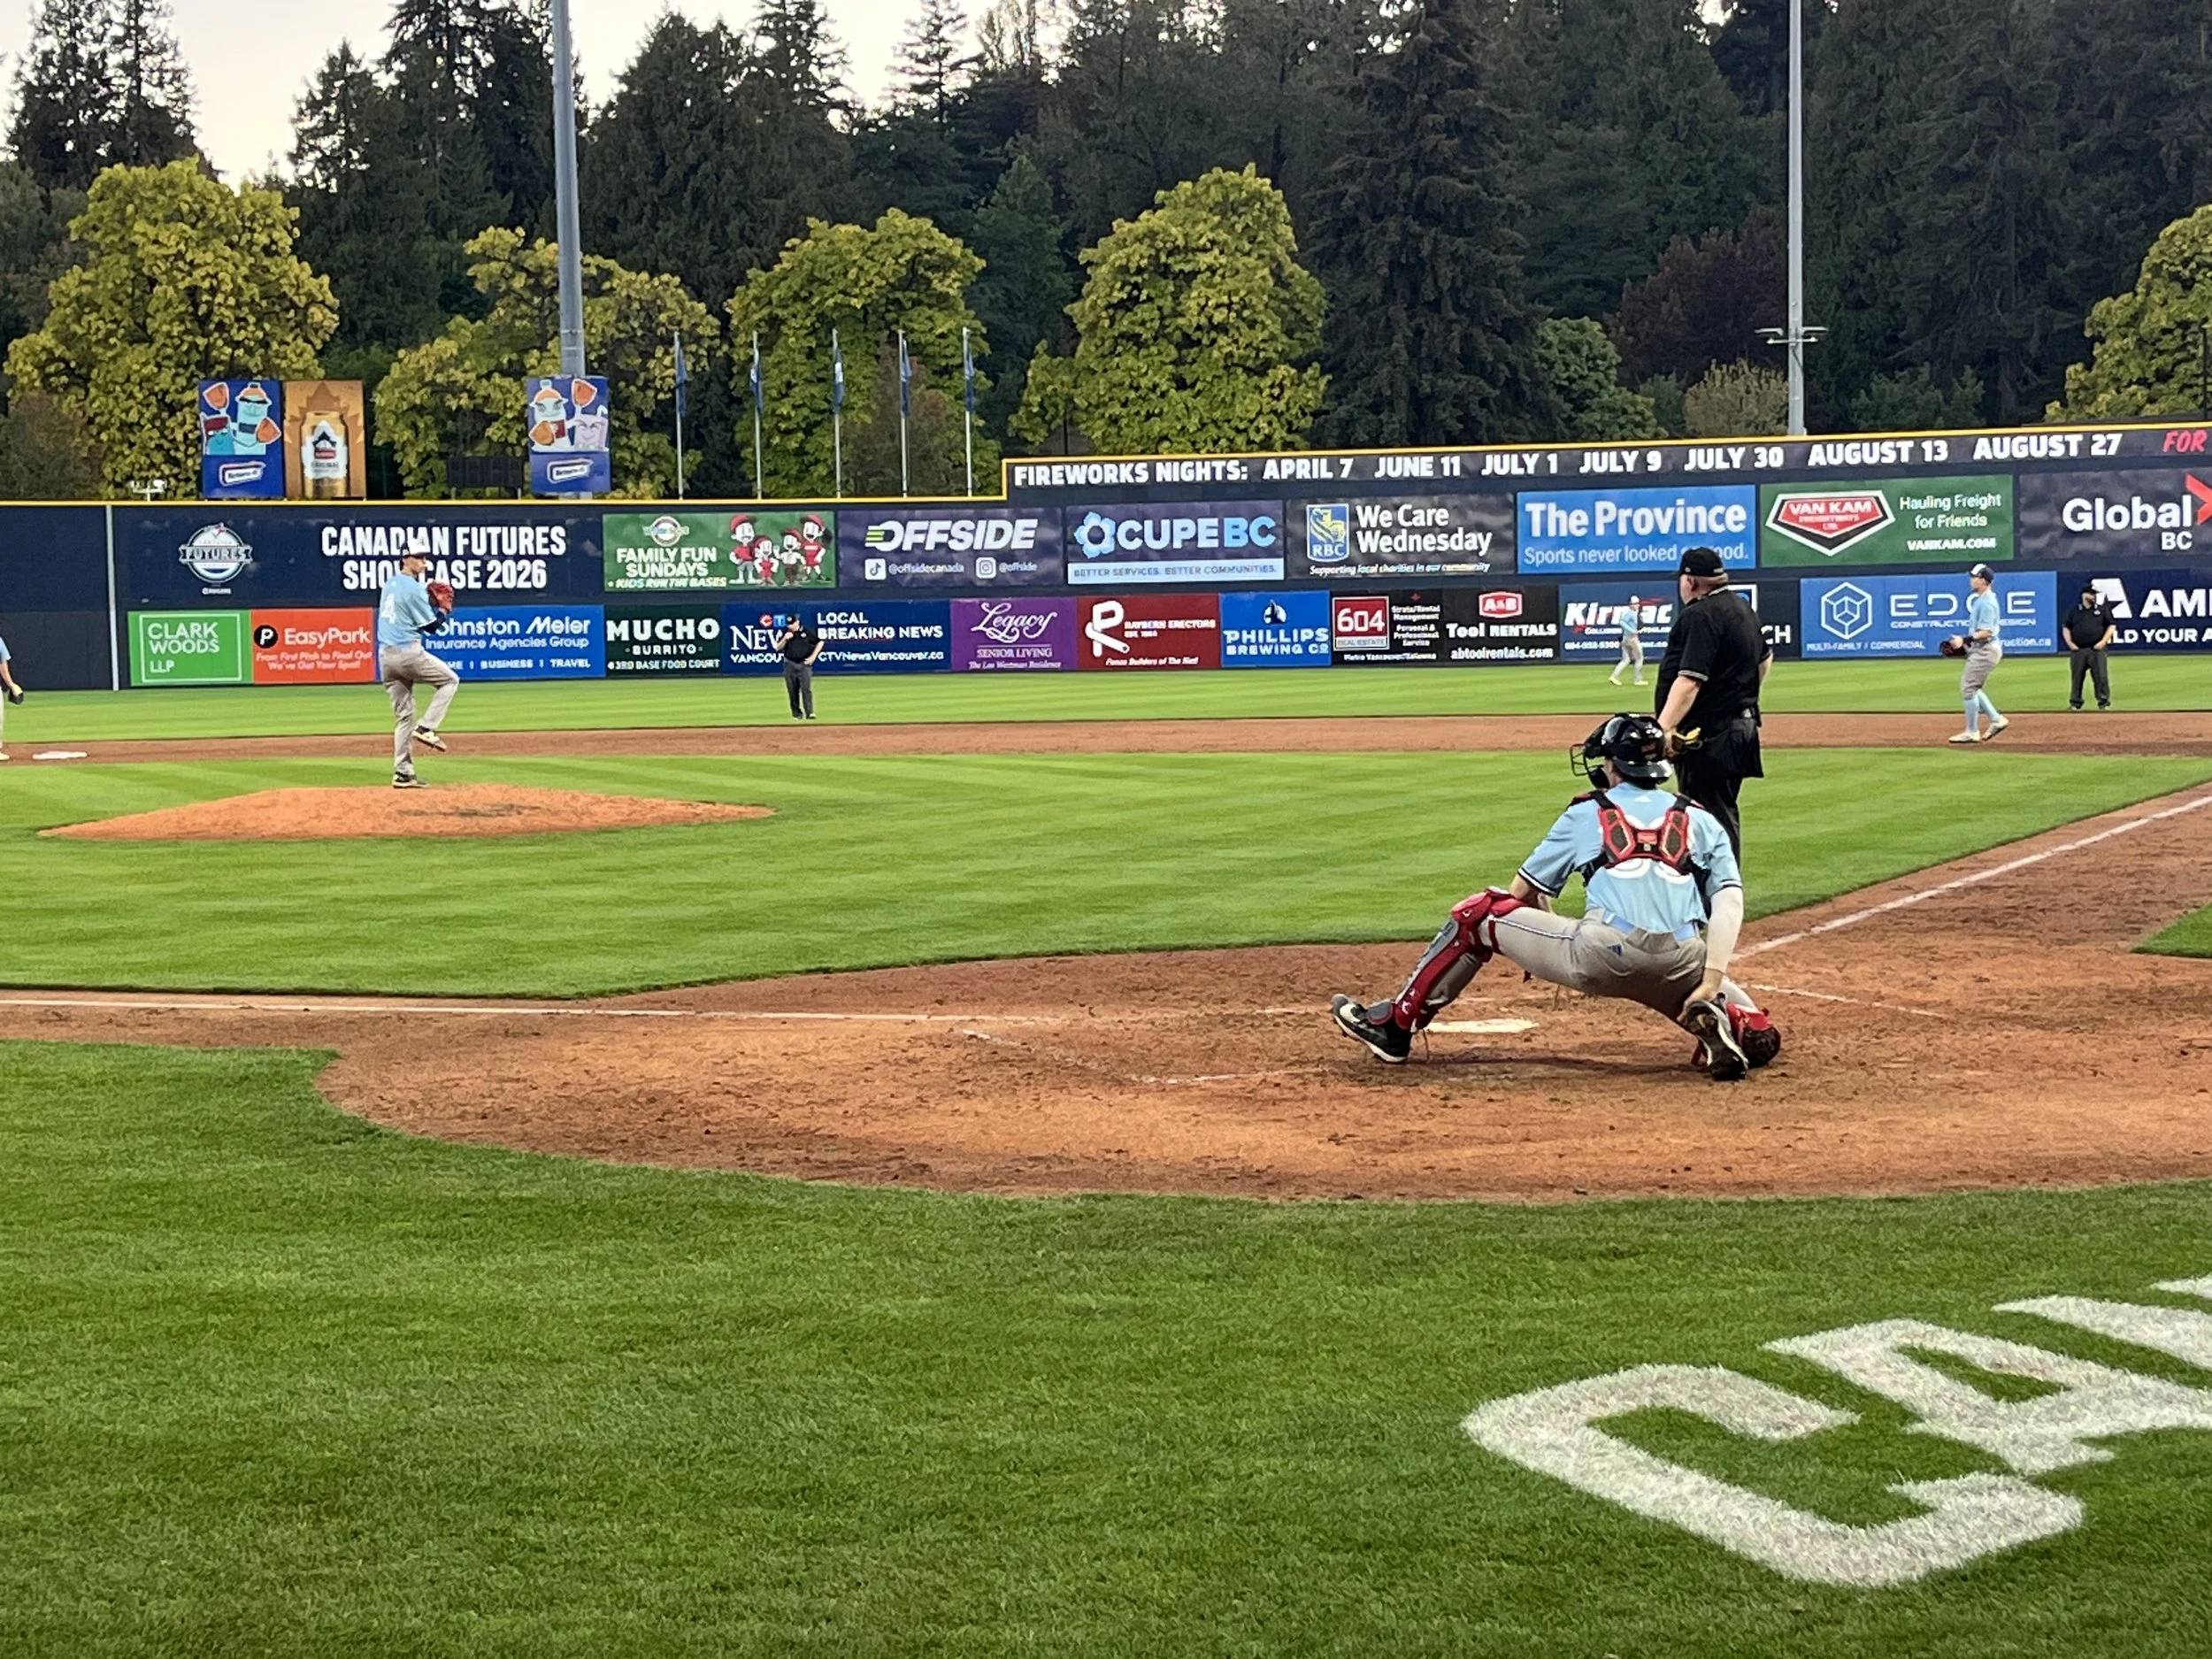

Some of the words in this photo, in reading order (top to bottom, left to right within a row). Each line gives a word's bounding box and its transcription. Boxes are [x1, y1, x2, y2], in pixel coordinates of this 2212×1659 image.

[1014, 463, 1148, 487] FIREWORKS
[1156, 460, 1248, 482] NIGHTS:
[1263, 458, 1333, 480] APRIL
[1339, 457, 1354, 479] 7
[1374, 456, 1433, 479] JUNE
[1440, 456, 1461, 477] 11
[1480, 453, 1539, 475] JULY
[1547, 452, 1558, 474] 1
[1578, 450, 1639, 474] JULY
[1647, 449, 1662, 472] 9
[1684, 447, 1746, 472] JULY
[1754, 446, 1785, 468] 30
[1808, 441, 1914, 466] AUGUST
[1921, 440, 1947, 462] 13
[1972, 434, 2083, 460] AUGUST
[2090, 434, 2123, 456] 27
[2162, 429, 2208, 453] FOR
[1789, 503, 1825, 515] VAN
[1829, 500, 1871, 513] KAM
[1900, 496, 1951, 511] Hauling
[1955, 494, 2001, 509] Freight
[1356, 505, 1393, 528] We
[1397, 503, 1449, 527] Care
[1525, 503, 1589, 537] The
[1594, 498, 1747, 536] Province
[2062, 495, 2192, 531] Global
[1915, 515, 1933, 529] for
[1938, 513, 1987, 527] Friends
[456, 526, 566, 556] FUTURES
[864, 518, 1038, 551] OFFSIDE
[1356, 527, 1493, 557] Wednesday
[2162, 531, 2193, 550] BC
[1312, 543, 1345, 557] RBC
[1907, 538, 1996, 551] VANKAM.COM
[186, 548, 246, 560] FUTURES
[617, 548, 679, 564] FAMILY
[680, 547, 717, 563] FUN
[1525, 546, 1575, 566] Sports
[1578, 548, 1621, 564] never
[1624, 544, 1677, 562] looked
[1717, 542, 1748, 560] ood.
[342, 558, 482, 590] SHOCASE
[487, 558, 547, 589] 2026
[626, 563, 709, 578] SUNDAYS
[1310, 565, 1356, 577] Supporting
[1357, 565, 1378, 573] local
[1379, 563, 1415, 573] charities
[616, 578, 645, 588] KIDS
[1483, 598, 1517, 611] A&B
[2139, 588, 2212, 618] AM
[424, 617, 520, 636] ohnston
[526, 616, 591, 634] Meier
[817, 612, 869, 625] LOCAL
[971, 602, 1057, 643] Legacy
[1168, 619, 1216, 628] ERECTORS
[1337, 608, 1386, 632] 604
[1891, 619, 1970, 629] CONSTRUCTIO
[148, 622, 219, 640] CLARK
[607, 618, 720, 641] MUCHO
[817, 626, 895, 640] BREAKING
[899, 625, 943, 638] NEWS
[1223, 628, 1329, 644] PHILLIPS
[1446, 622, 1485, 638] Tool
[1489, 623, 1557, 637] RENTALS
[2142, 628, 2198, 642] YOUR
[284, 626, 371, 649] EasyPark
[426, 639, 487, 649] Insurance
[488, 637, 548, 650] Agencies
[549, 636, 589, 649] Group
[730, 626, 784, 650] NEW
[149, 638, 220, 655] WOODS
[633, 644, 696, 655] BURRITO
[977, 649, 1015, 658] SENIOR
[1016, 648, 1053, 658] LIVING
[1226, 645, 1302, 656] BREWING
[1451, 646, 1554, 659] abtoolrentals.com
[1807, 642, 1862, 652] MULTI-FAMILY
[1870, 641, 1925, 650] COMMERCIAL
[256, 652, 278, 662] From
[480, 659, 534, 670] BUSINESS
[549, 658, 591, 668] TRAVEL
[635, 660, 660, 670] BASE
[662, 660, 687, 670] FOOD
[688, 658, 720, 669] COURT
[730, 653, 784, 664] VANCOU
[818, 651, 944, 662] CTVNewsVancouver.ca
[150, 659, 175, 673] LLP
